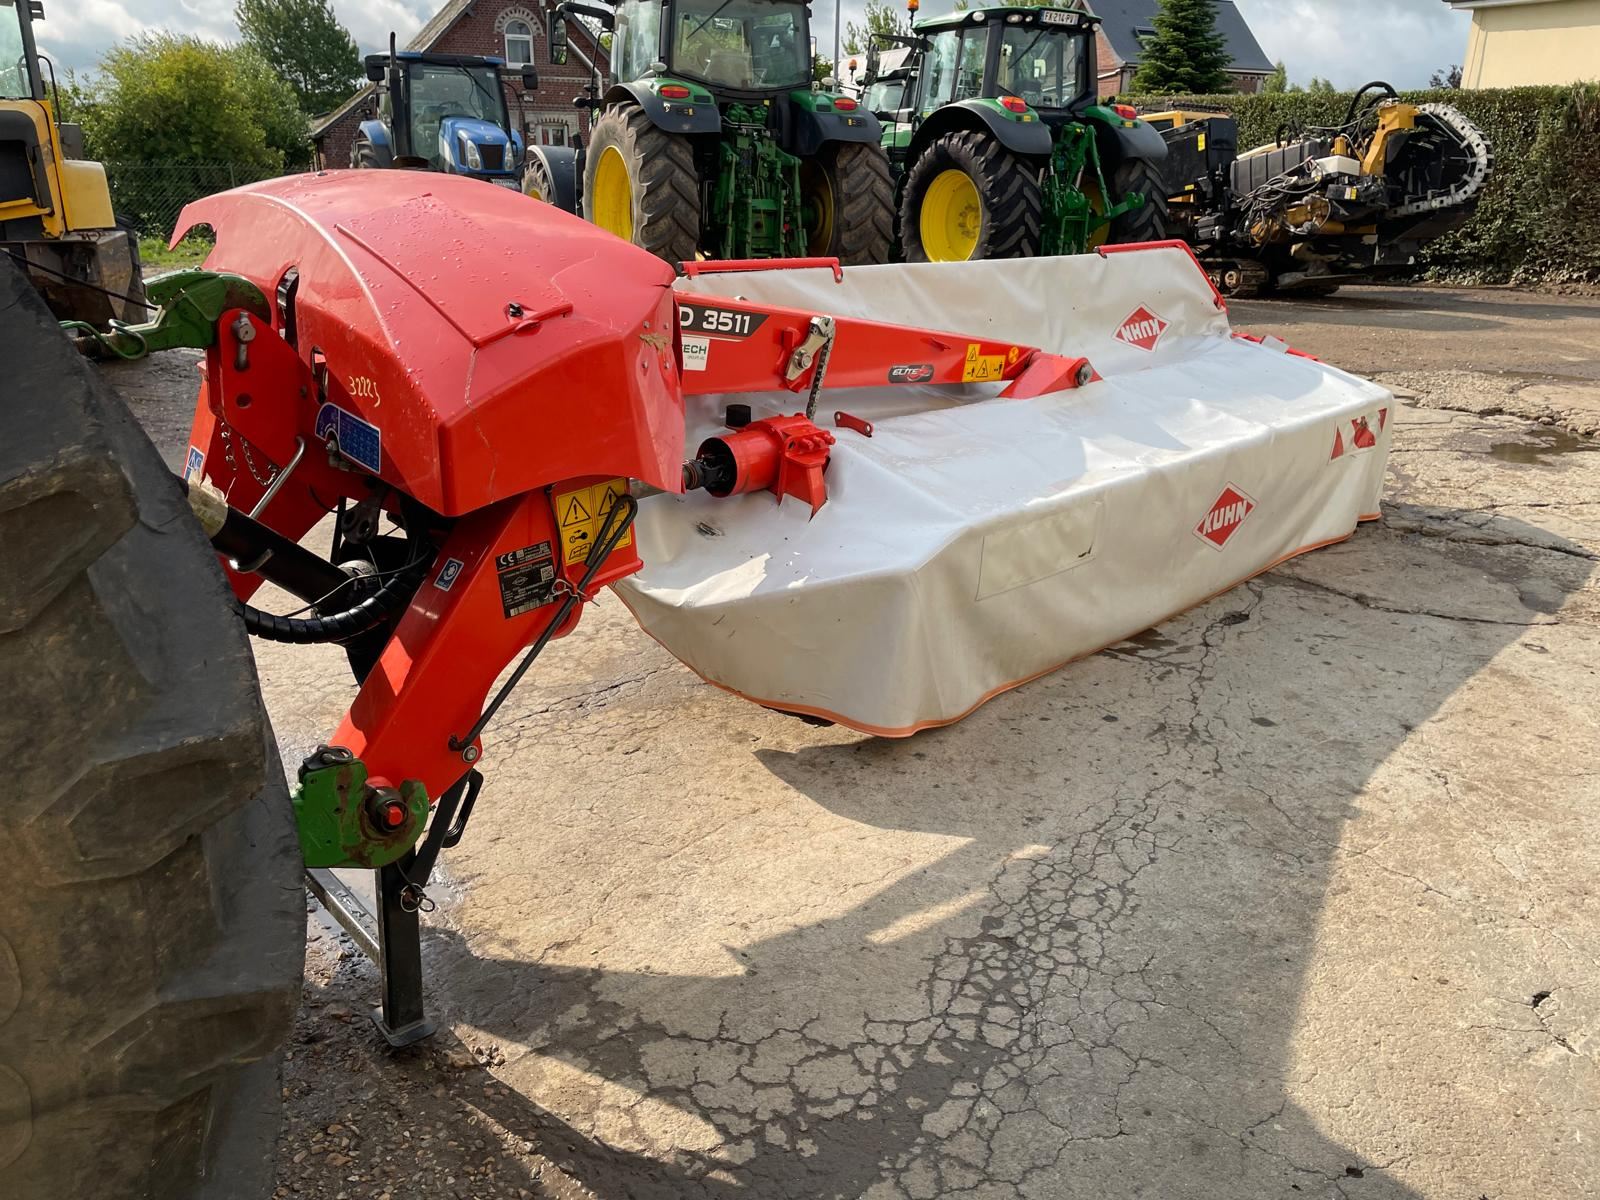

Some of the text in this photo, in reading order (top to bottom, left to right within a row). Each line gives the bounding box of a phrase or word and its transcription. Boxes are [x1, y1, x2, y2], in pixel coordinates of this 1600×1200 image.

[702, 310, 751, 334] 3511
[682, 344, 708, 355] ECH
[1202, 499, 1248, 536] KUHN
